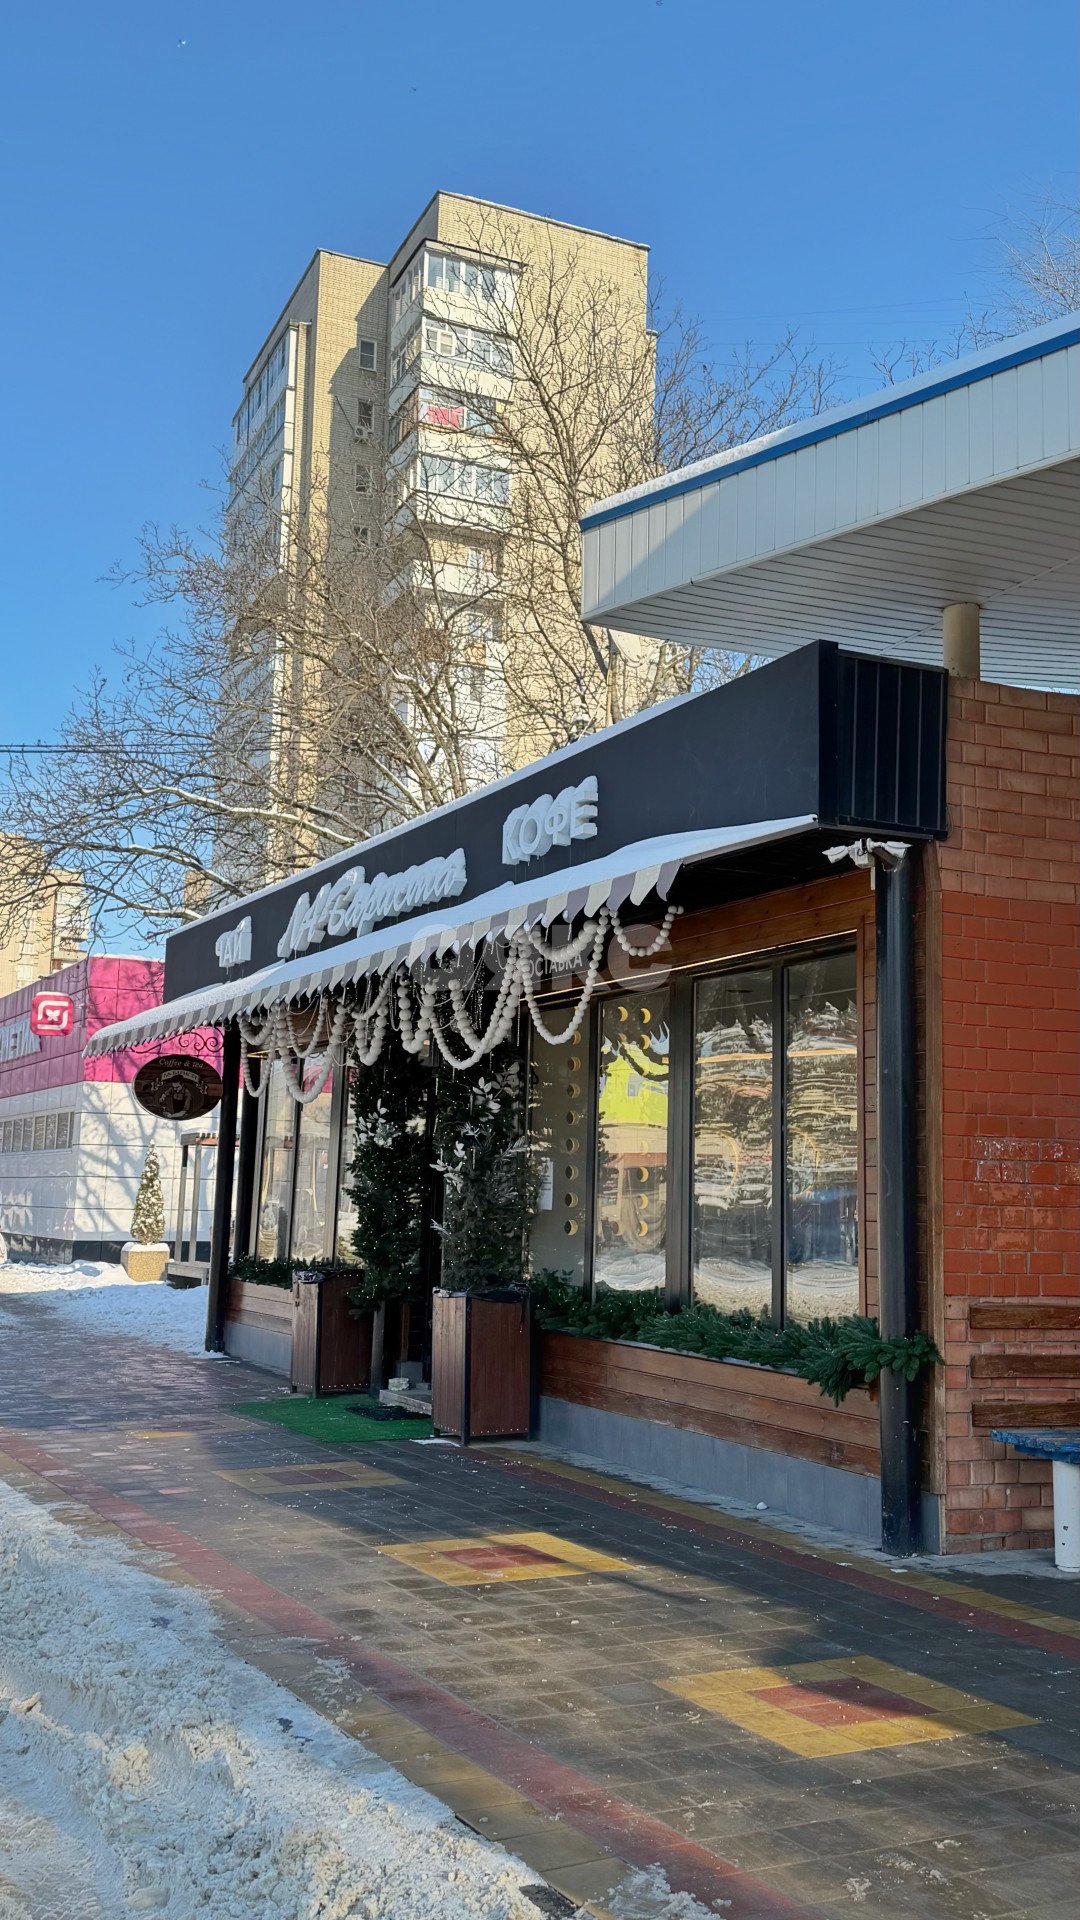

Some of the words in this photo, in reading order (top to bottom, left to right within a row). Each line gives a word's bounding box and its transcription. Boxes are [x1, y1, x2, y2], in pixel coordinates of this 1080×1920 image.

[502, 776, 599, 864] КОФЕ
[527, 954, 583, 978] ОСТАВКА
[159, 1058, 182, 1067] Coffee
